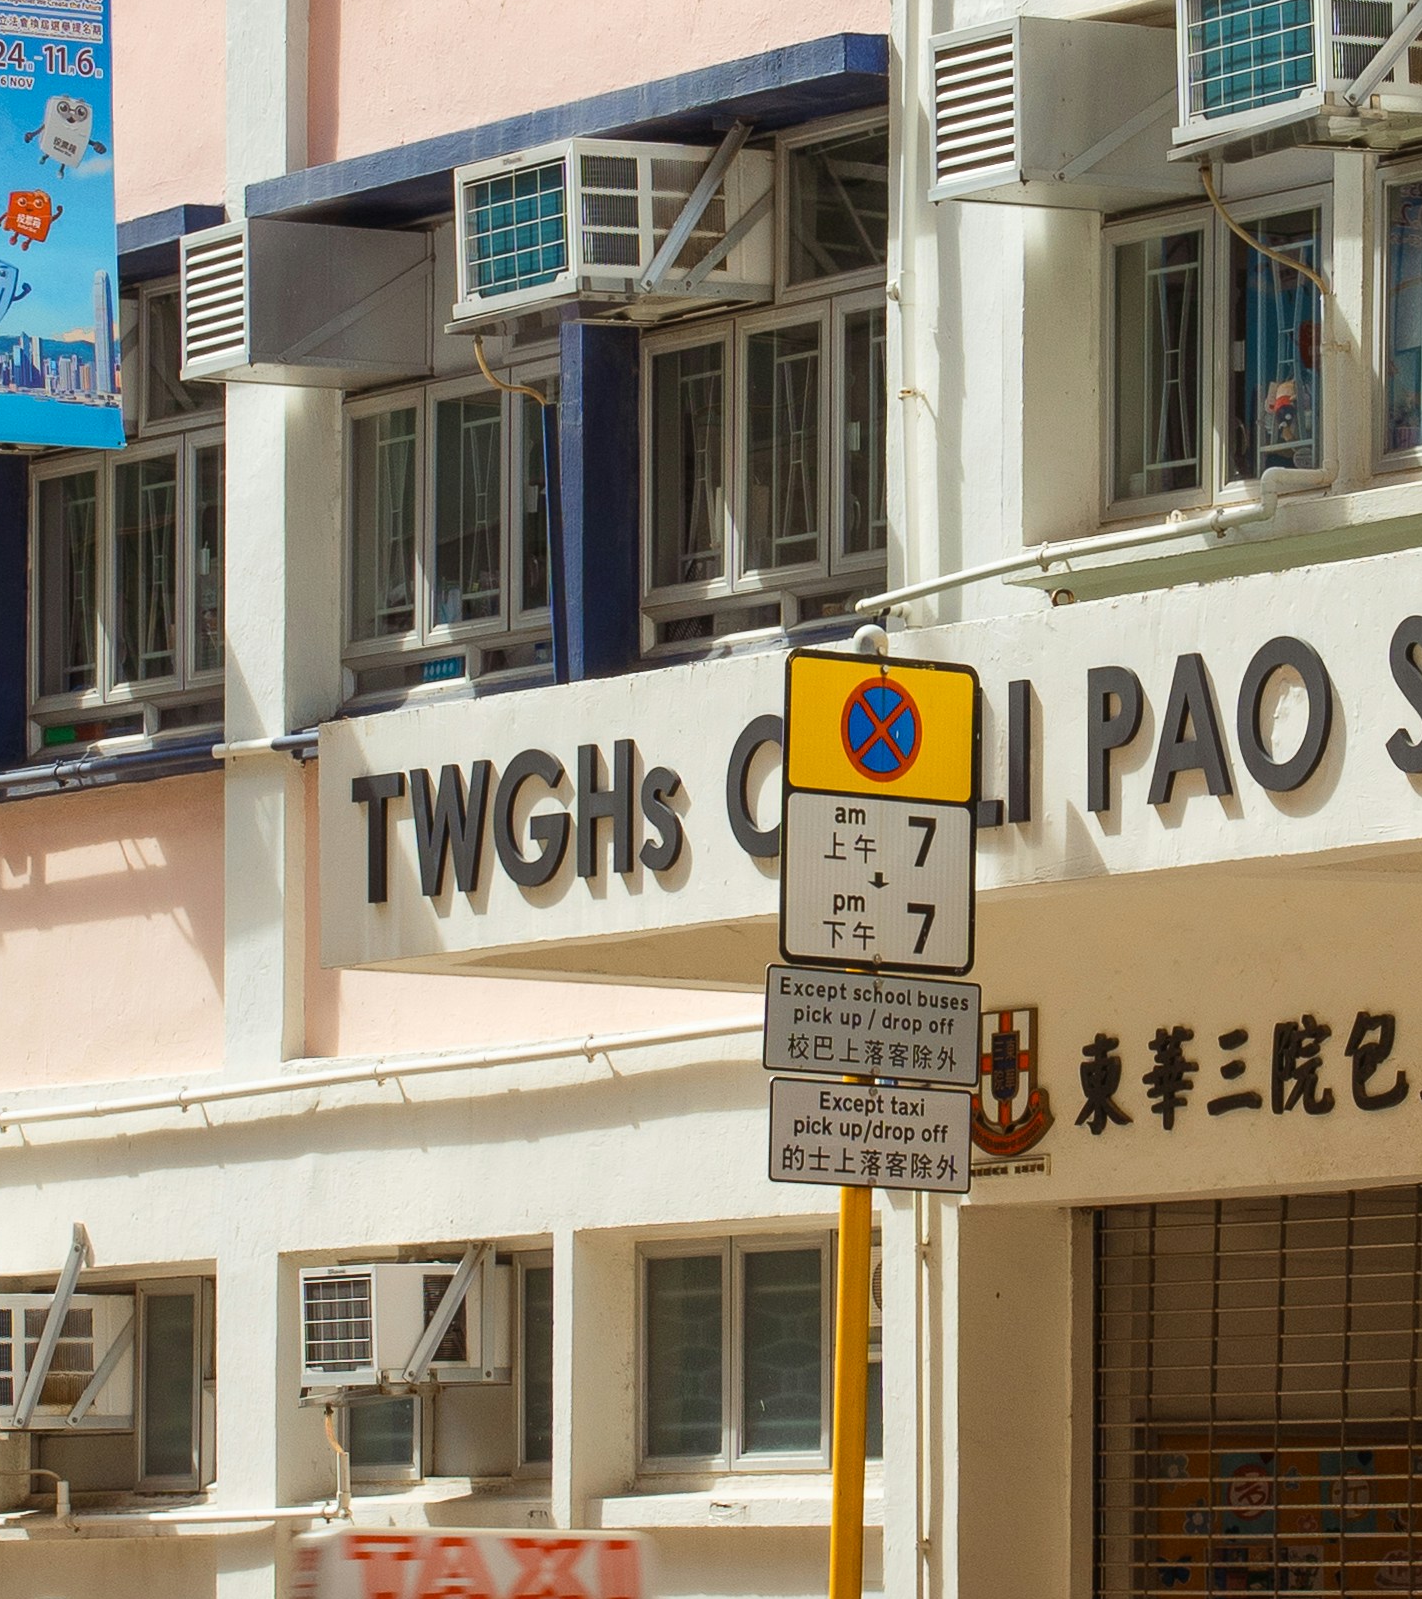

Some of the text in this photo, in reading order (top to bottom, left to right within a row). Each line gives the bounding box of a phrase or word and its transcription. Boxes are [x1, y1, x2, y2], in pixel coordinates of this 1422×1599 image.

[0, 74, 7, 86] 6
[9, 76, 33, 90] NOV
[351, 738, 683, 904] TWGHs
[1086, 635, 1336, 814] PAO
[834, 806, 866, 826] am
[824, 832, 877, 864] 上午
[908, 815, 937, 868] 7
[833, 892, 866, 915] pm
[823, 920, 876, 951] 下午
[907, 902, 936, 954] 7
[780, 976, 970, 1012] Except school buses
[793, 1005, 832, 1025] pick
[840, 1011, 862, 1029] up
[882, 1012, 922, 1036] drop
[928, 1018, 955, 1036] off
[787, 1032, 957, 1073] 校巴上落客除外
[819, 1090, 926, 1117] Except taxi
[793, 1116, 949, 1144] pick up/drop off
[781, 1144, 959, 1181] 的士上落客除外
